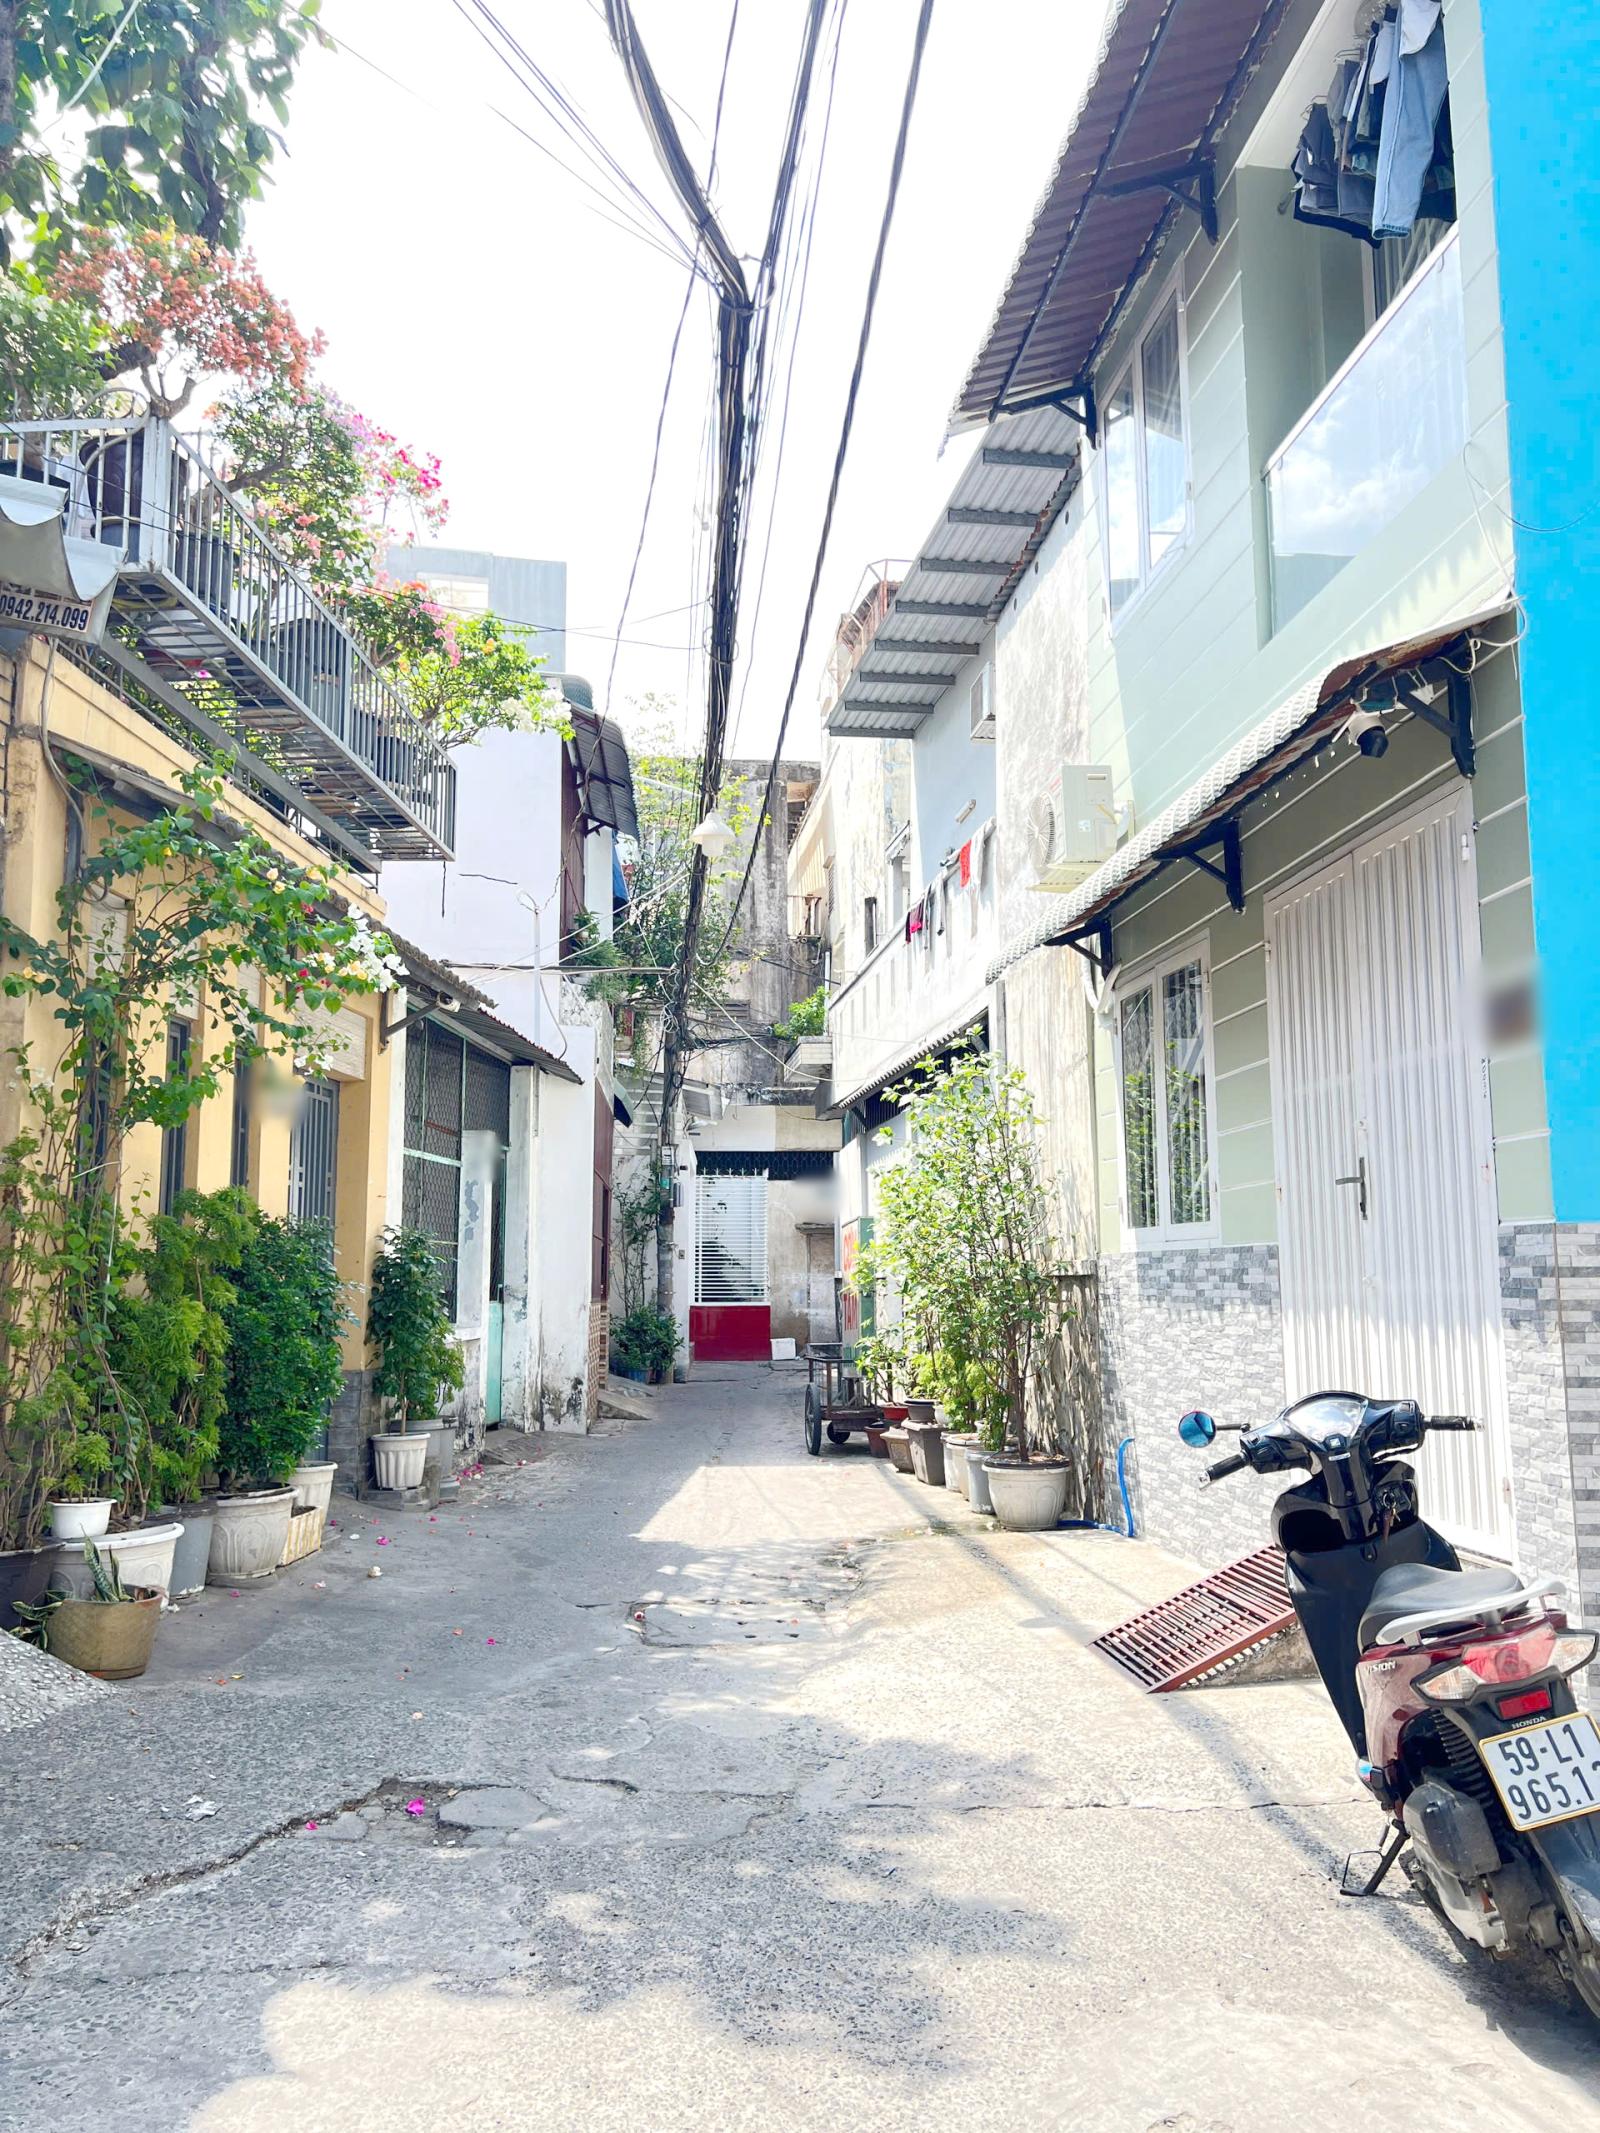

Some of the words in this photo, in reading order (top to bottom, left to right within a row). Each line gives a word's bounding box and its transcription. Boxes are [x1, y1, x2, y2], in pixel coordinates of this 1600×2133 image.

[0, 594, 89, 631] 0942.214.099
[1511, 1716, 1548, 1730] HONDA
[1498, 1723, 1585, 1776] 59-L1
